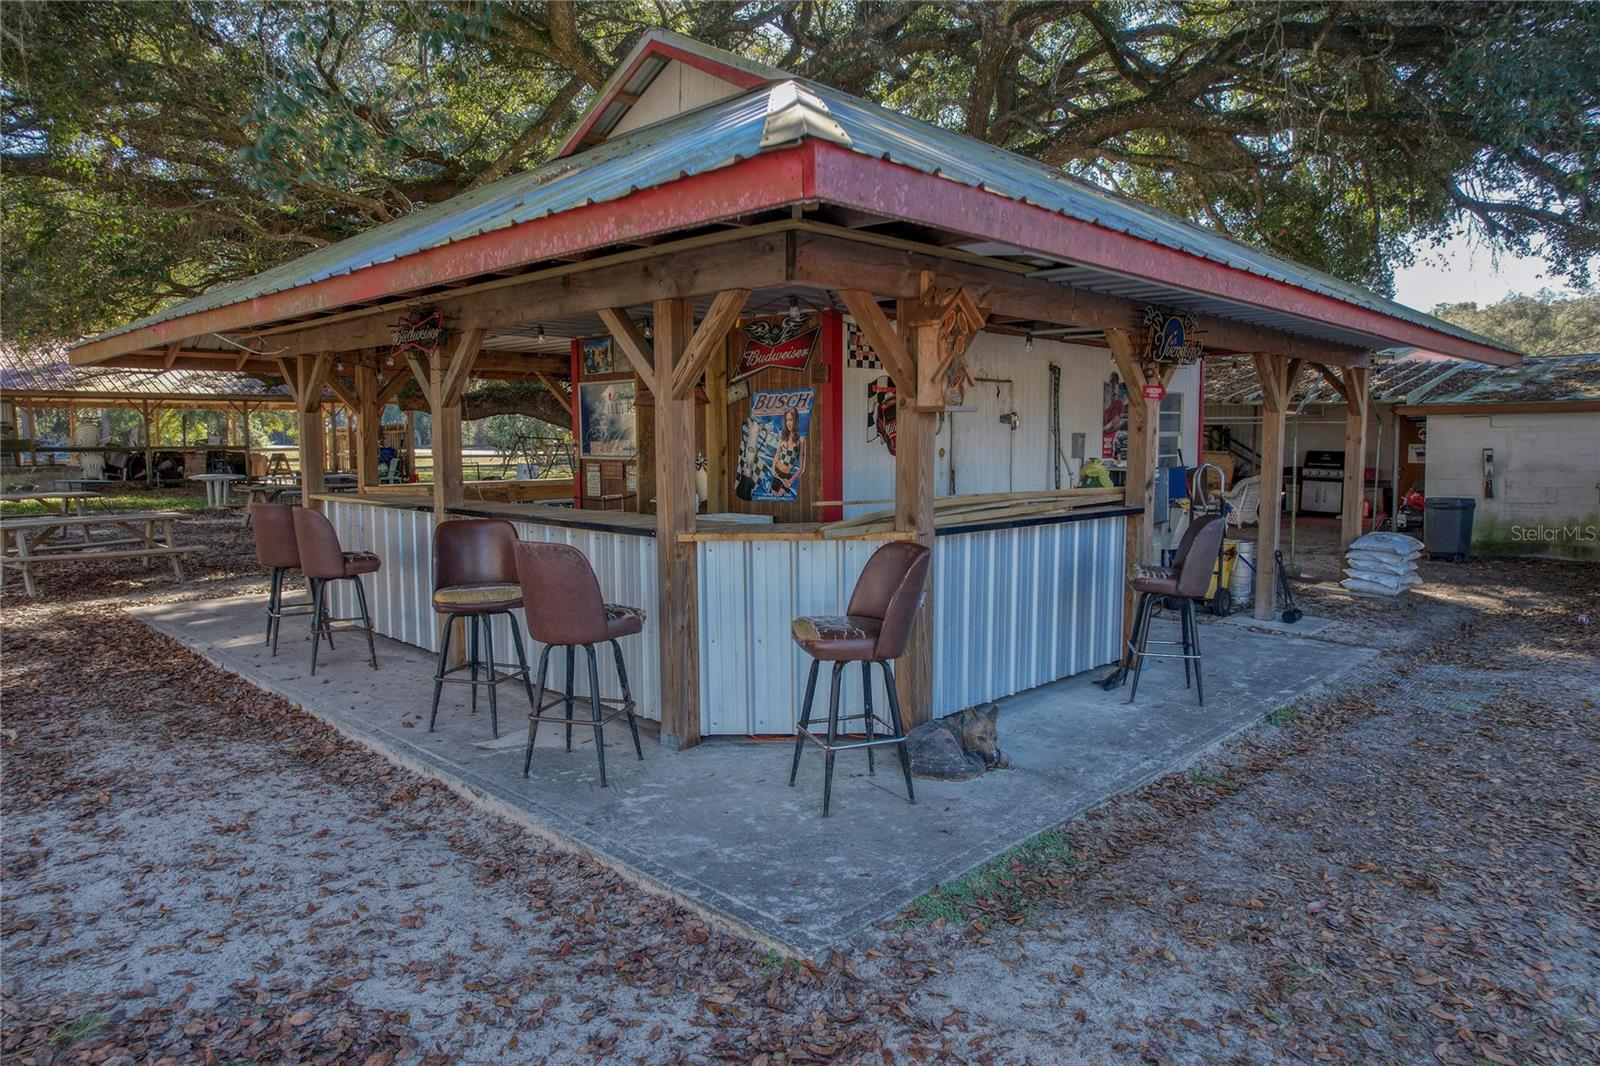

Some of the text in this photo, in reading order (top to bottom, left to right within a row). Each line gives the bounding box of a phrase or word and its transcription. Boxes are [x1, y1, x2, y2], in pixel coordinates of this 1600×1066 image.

[391, 325, 442, 346] Budweiser
[743, 346, 810, 367] Budweiser
[753, 391, 813, 411] BUSCH
